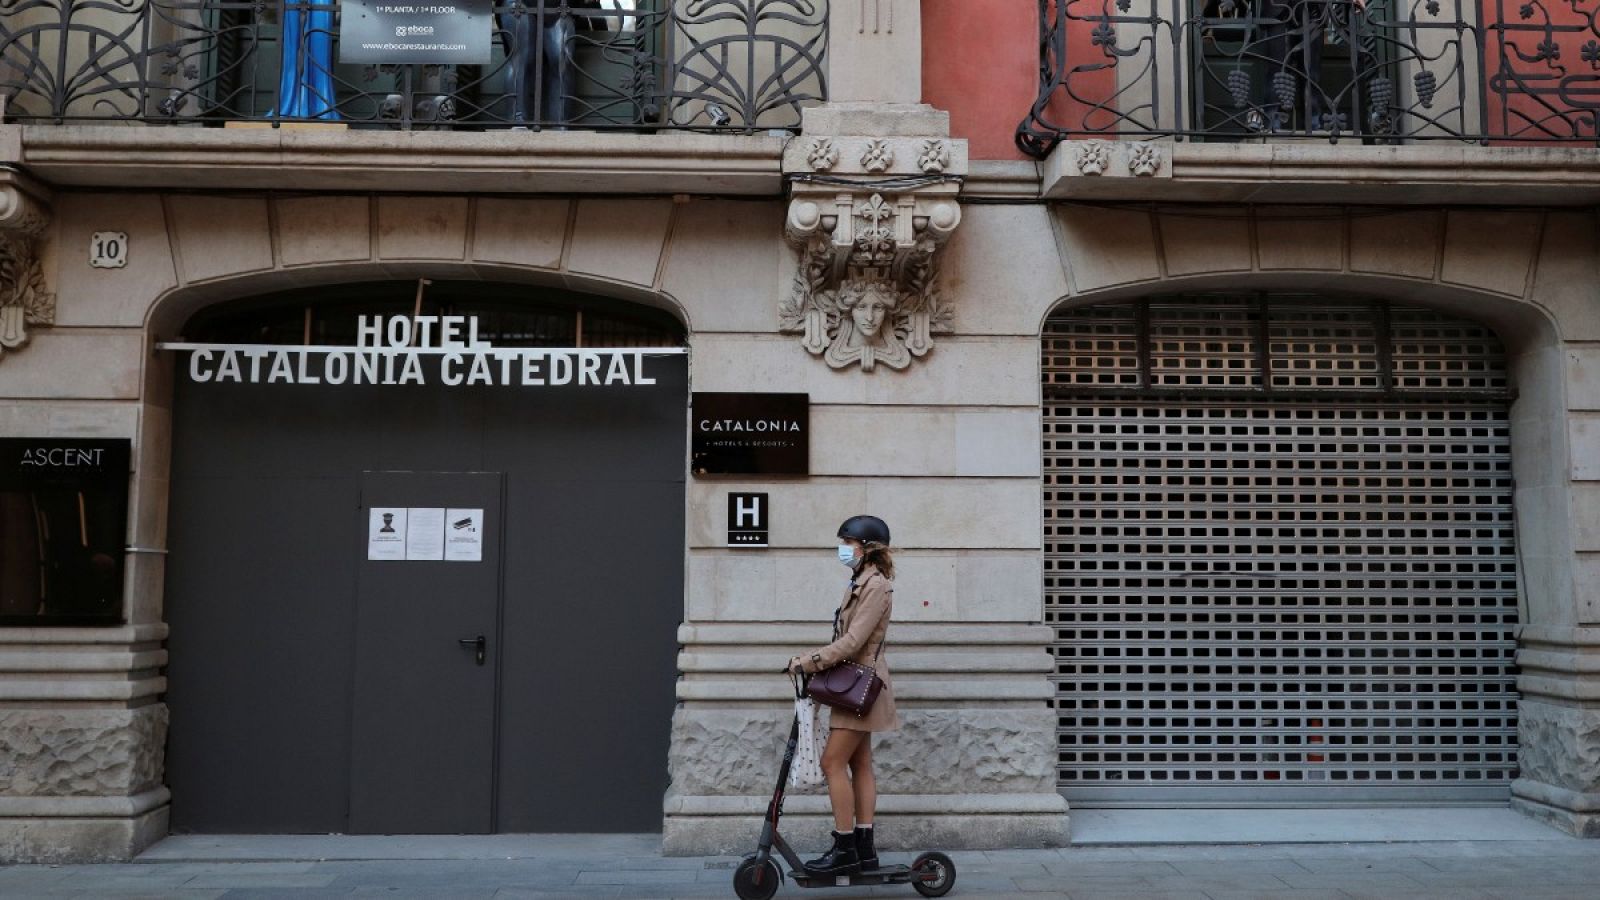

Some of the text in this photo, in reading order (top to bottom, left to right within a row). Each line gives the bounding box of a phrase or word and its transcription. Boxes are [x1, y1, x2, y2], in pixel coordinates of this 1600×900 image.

[430, 6, 456, 14] FLOOR
[408, 25, 434, 33] eboca
[362, 42, 466, 51] www.ebocarestaurants.com
[97, 240, 119, 259] 10
[357, 315, 491, 348] HOTEL
[190, 350, 656, 386] CATALONIA CATEDRAL
[700, 420, 800, 432] CATALONIA
[20, 448, 105, 466] ASCENT
[736, 496, 760, 527] H
